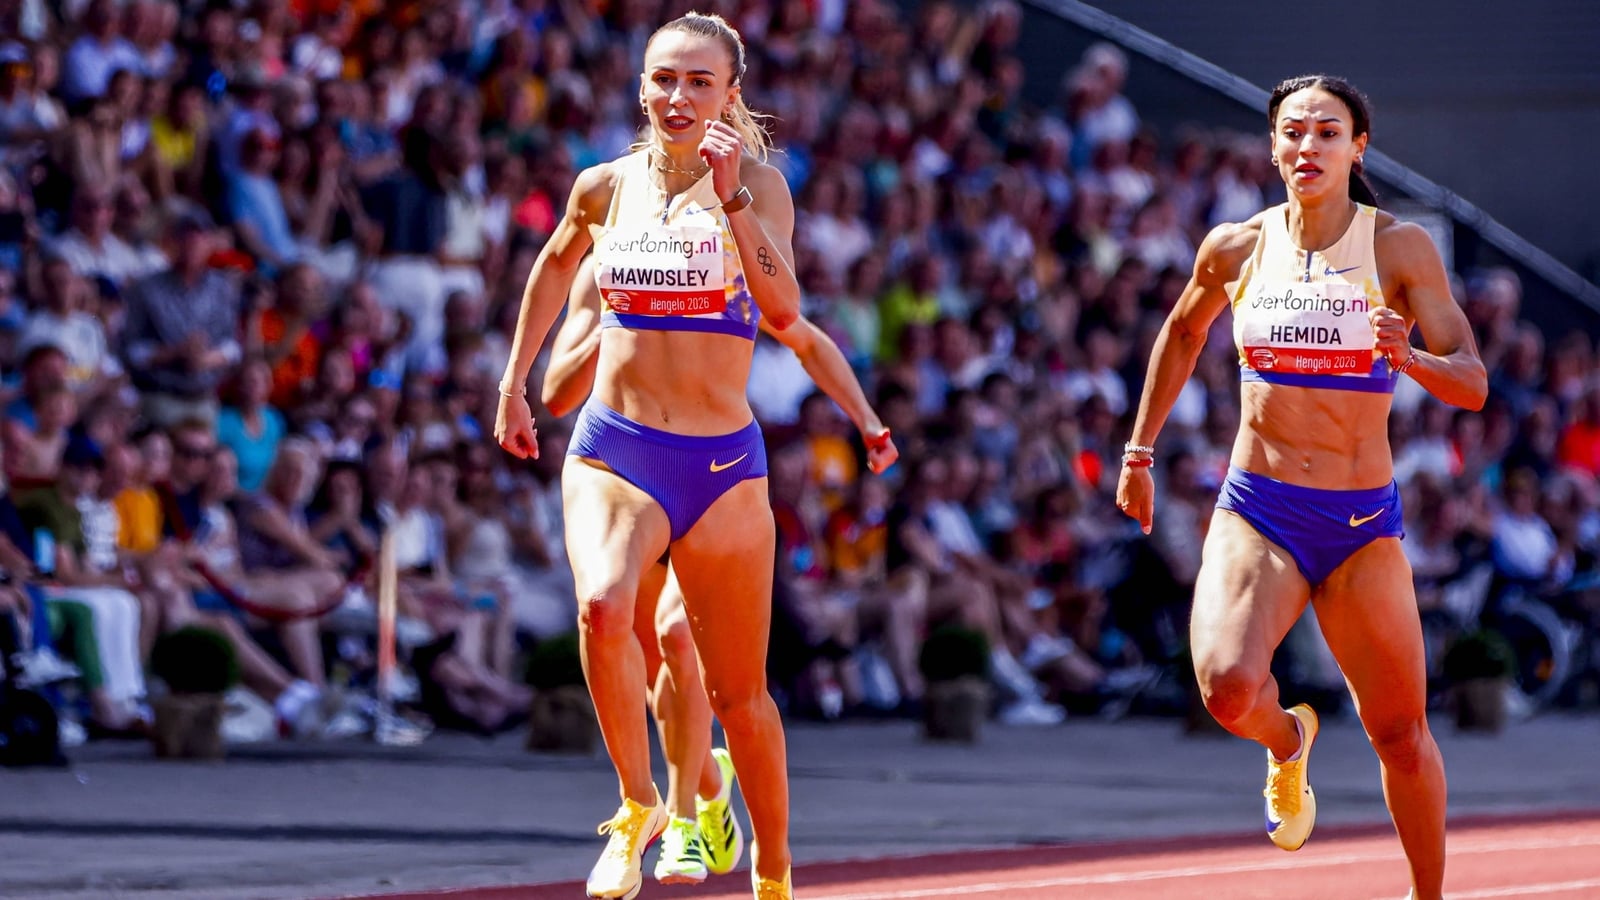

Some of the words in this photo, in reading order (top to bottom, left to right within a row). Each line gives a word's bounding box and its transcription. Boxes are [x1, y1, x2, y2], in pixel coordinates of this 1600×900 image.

[611, 267, 709, 287] MAWDSLEY
[650, 297, 685, 314] Hengelo
[687, 297, 710, 311] 2026
[1270, 325, 1342, 345] HEMIDA
[1295, 355, 1332, 373] Hengelo
[1333, 356, 1356, 369] 2026
